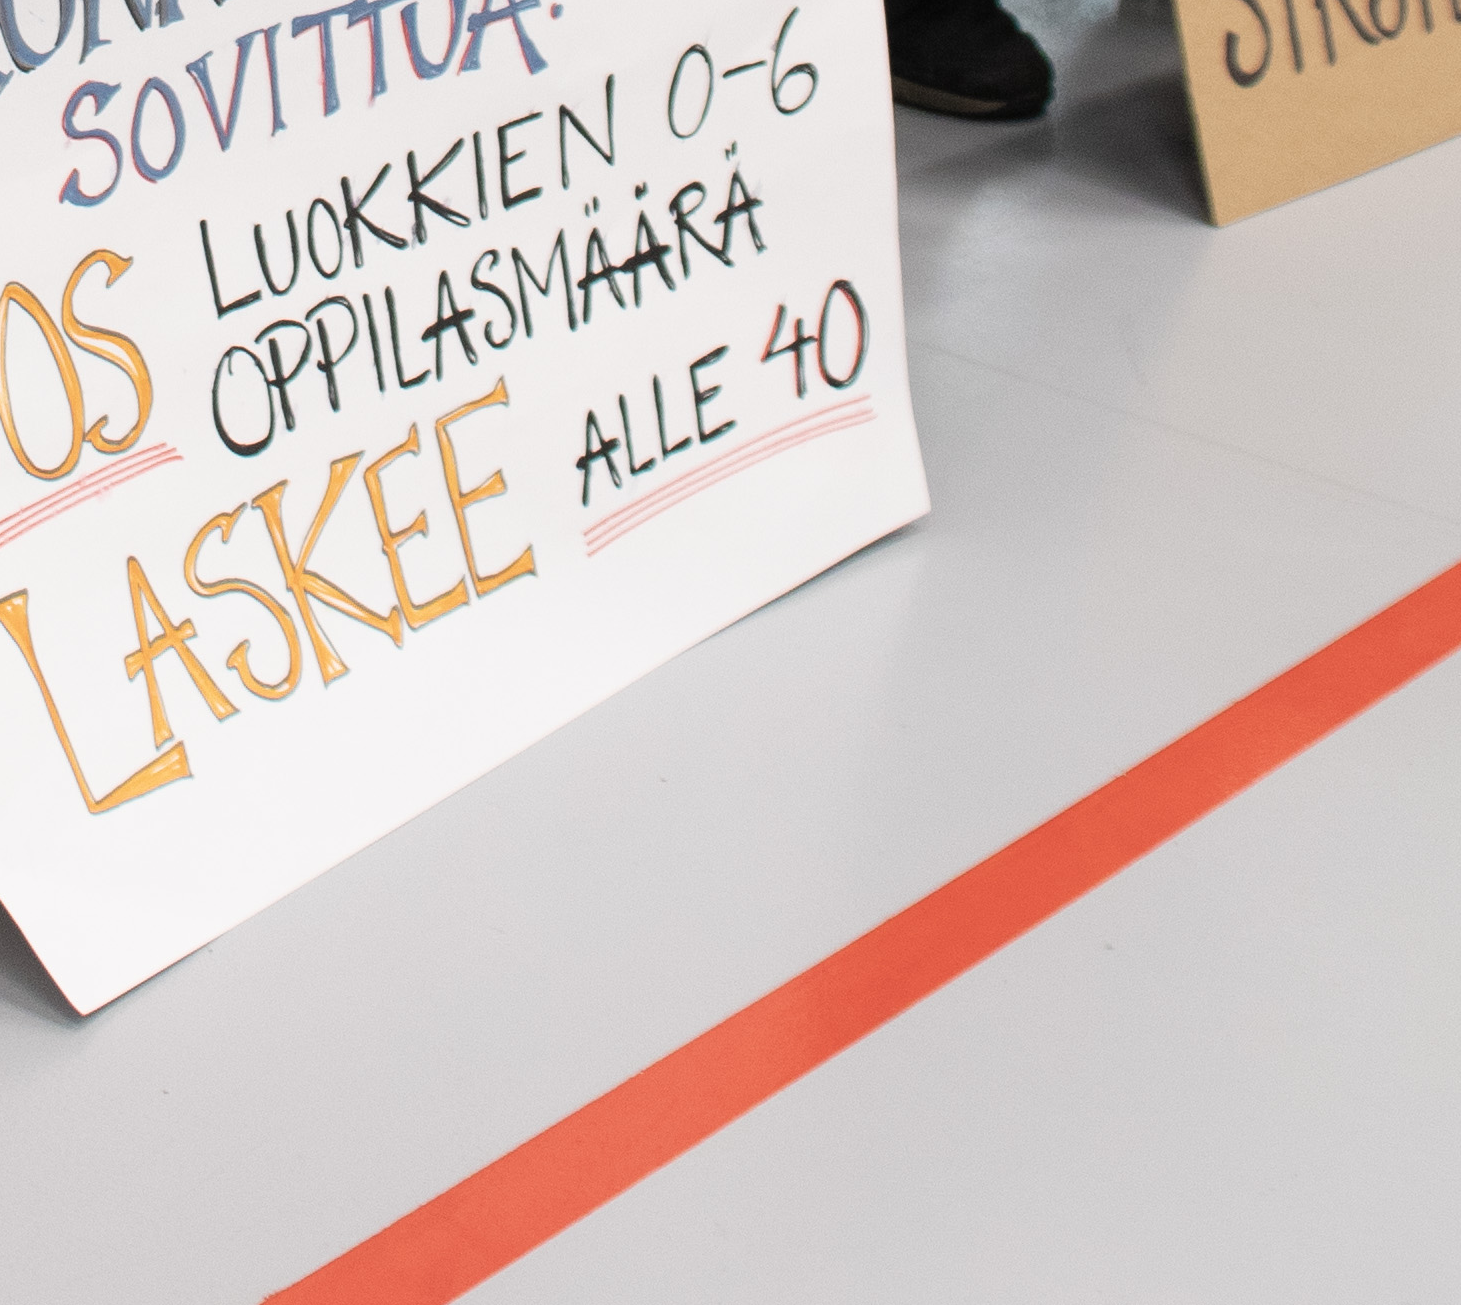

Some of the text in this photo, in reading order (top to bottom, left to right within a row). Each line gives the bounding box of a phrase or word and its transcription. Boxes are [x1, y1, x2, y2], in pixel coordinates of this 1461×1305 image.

[199, 7, 819, 317] LUOKKIEN 0-6
[211, 142, 768, 457] OPPILASMÄÄRÄ
[576, 345, 737, 506] ALLE
[761, 279, 871, 399] 40
